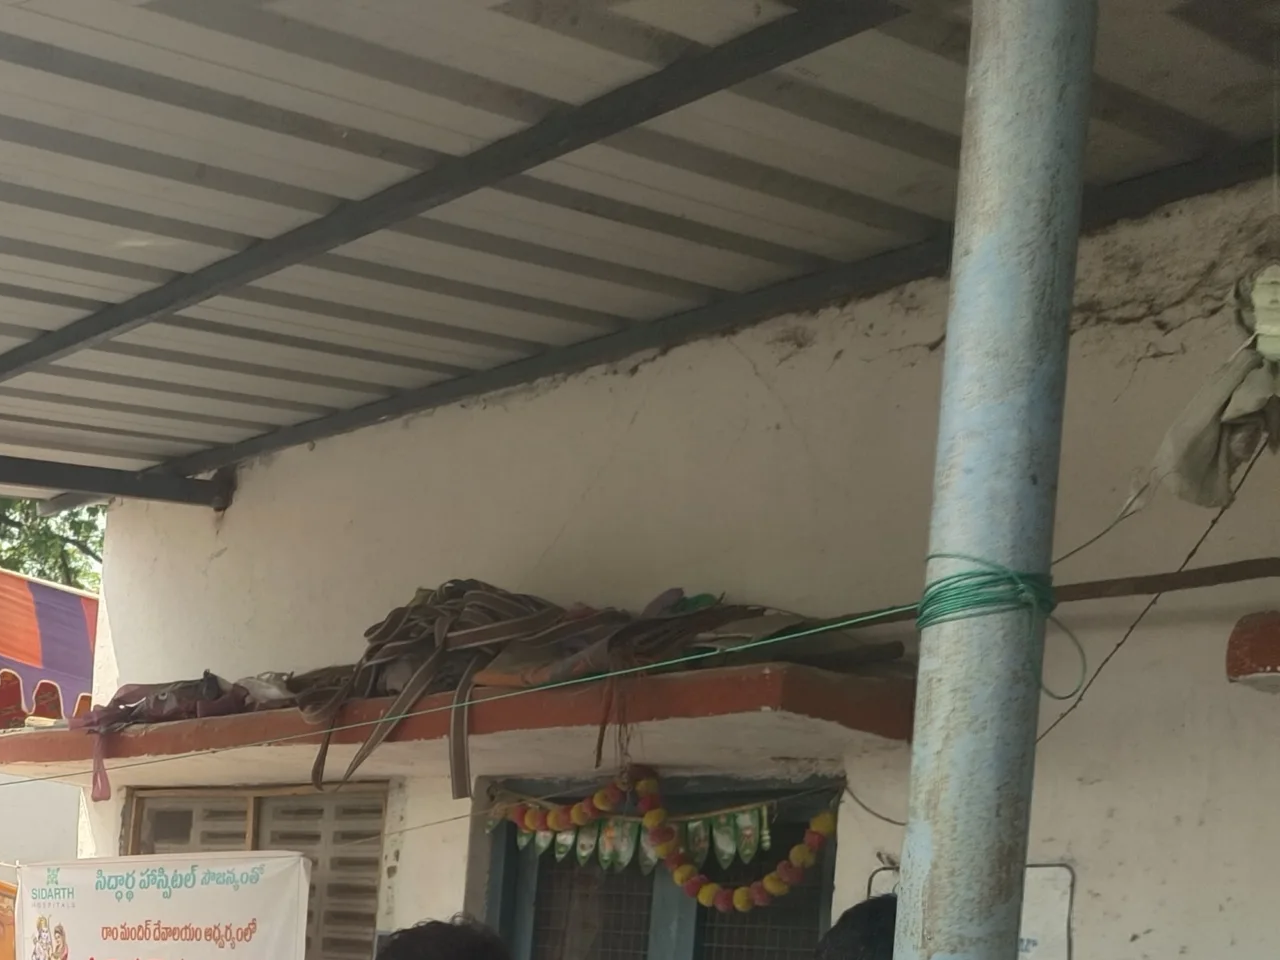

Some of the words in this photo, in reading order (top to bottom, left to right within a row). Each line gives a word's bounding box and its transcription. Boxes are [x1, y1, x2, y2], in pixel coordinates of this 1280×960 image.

[138, 865, 199, 899] హాస్పిటల్
[31, 887, 75, 900] SIDARTH
[31, 901, 76, 909] HOSPITALS
